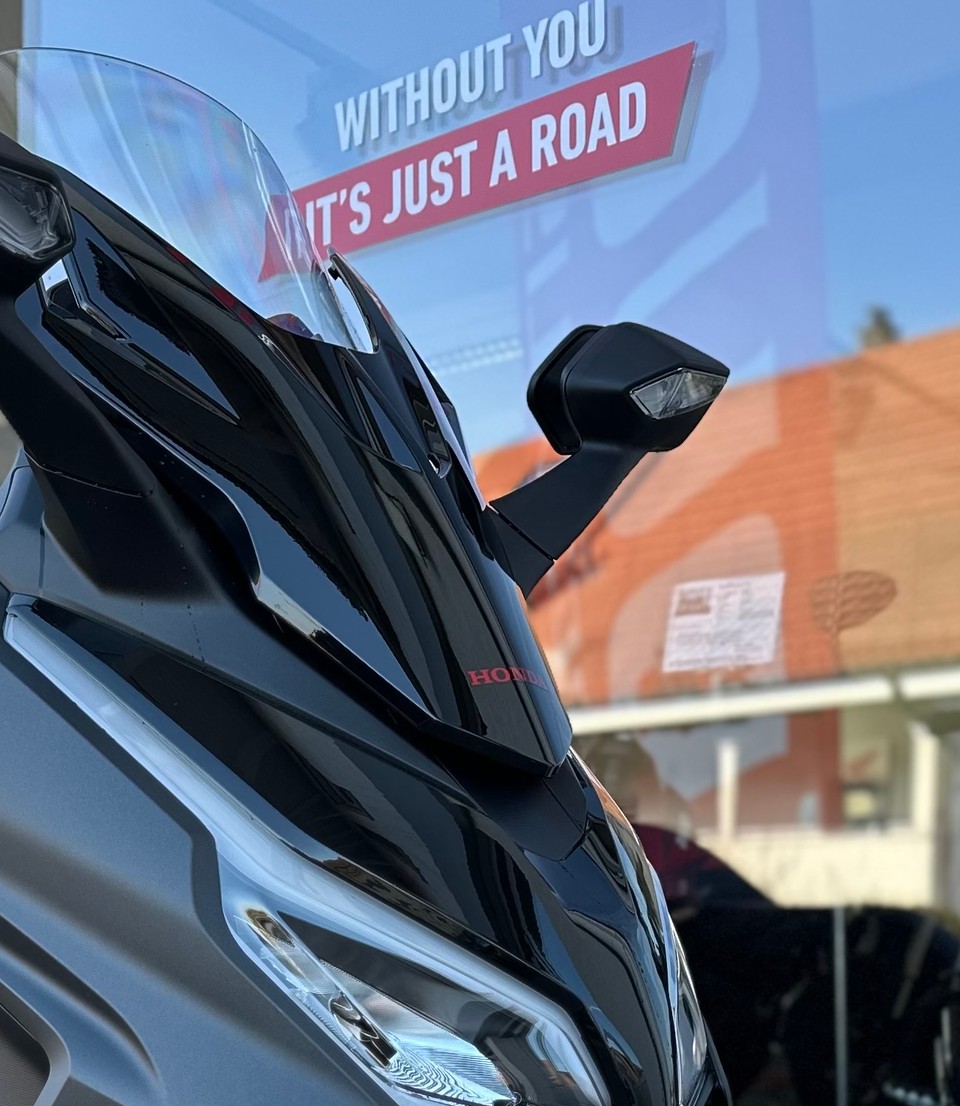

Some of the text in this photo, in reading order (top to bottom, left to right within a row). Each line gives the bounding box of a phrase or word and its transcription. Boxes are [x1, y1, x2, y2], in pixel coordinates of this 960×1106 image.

[334, 0, 606, 152] WITHOUT YOU
[305, 82, 647, 246] IT'S JUST A ROAD
